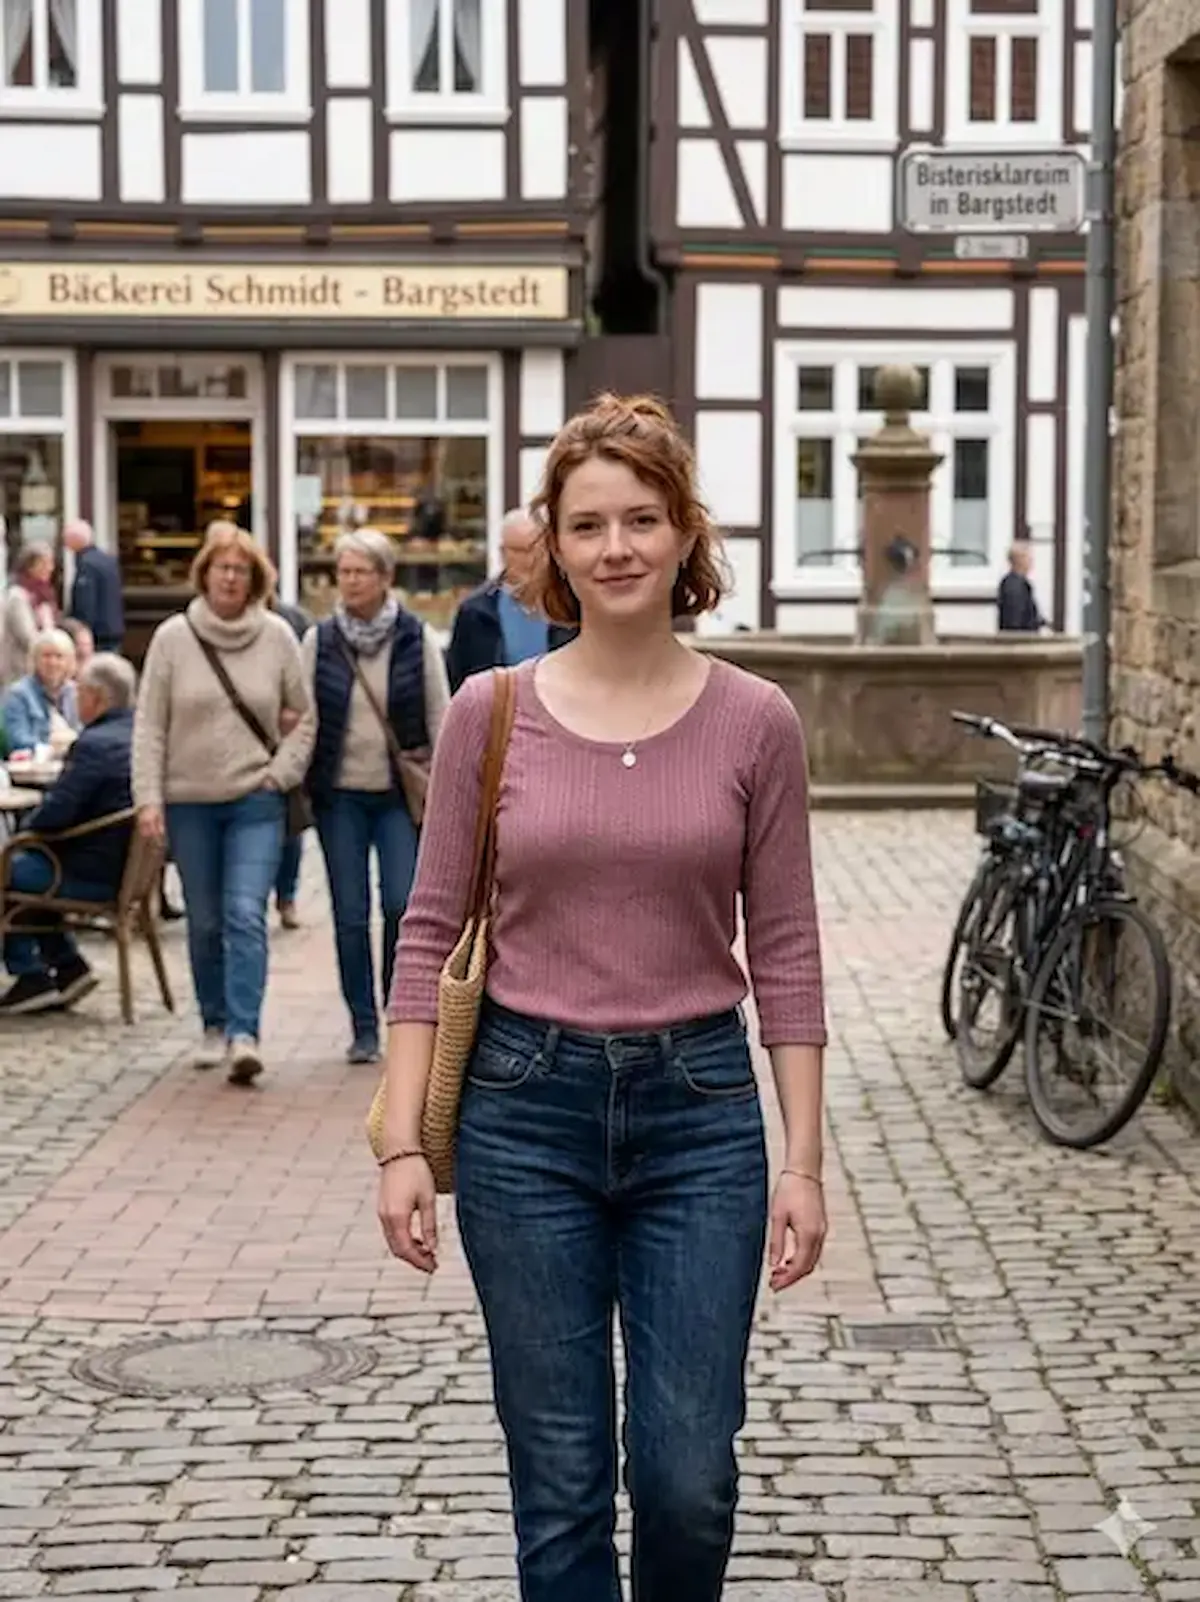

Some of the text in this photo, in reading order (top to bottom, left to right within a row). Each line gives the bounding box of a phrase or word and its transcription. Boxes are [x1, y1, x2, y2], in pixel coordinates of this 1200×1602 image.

[930, 191, 1057, 220] in Bargstedt
[49, 272, 192, 304] Bäckerei
[206, 273, 341, 305] Schmidt
[383, 275, 541, 313] Bargstedt
